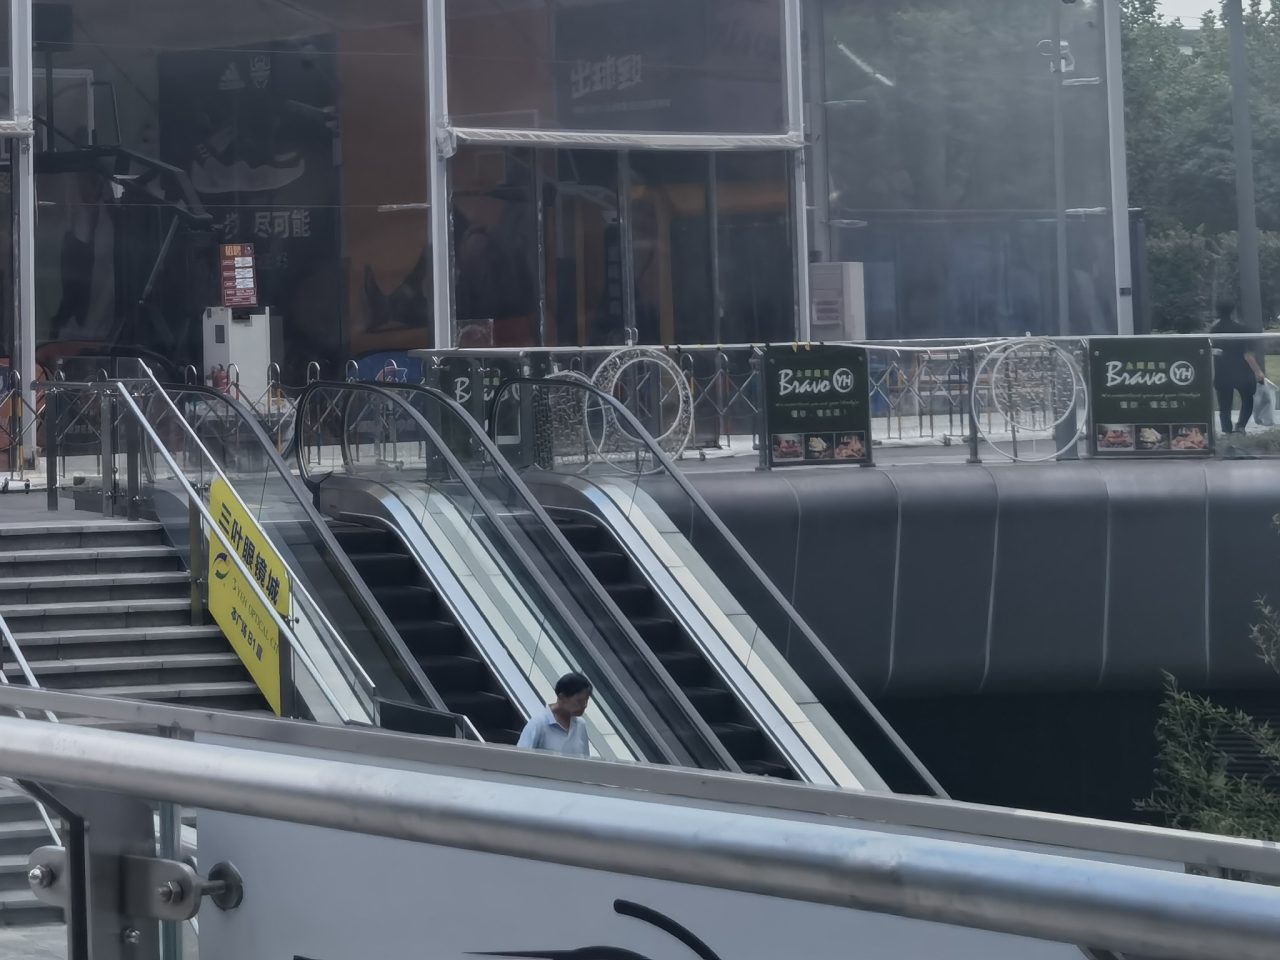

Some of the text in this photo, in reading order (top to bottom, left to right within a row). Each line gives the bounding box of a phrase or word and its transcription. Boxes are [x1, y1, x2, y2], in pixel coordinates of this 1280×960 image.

[778, 368, 831, 396] Bravo
[1104, 360, 1168, 387] Bravo
[218, 501, 280, 606] 三叶眼镜城
